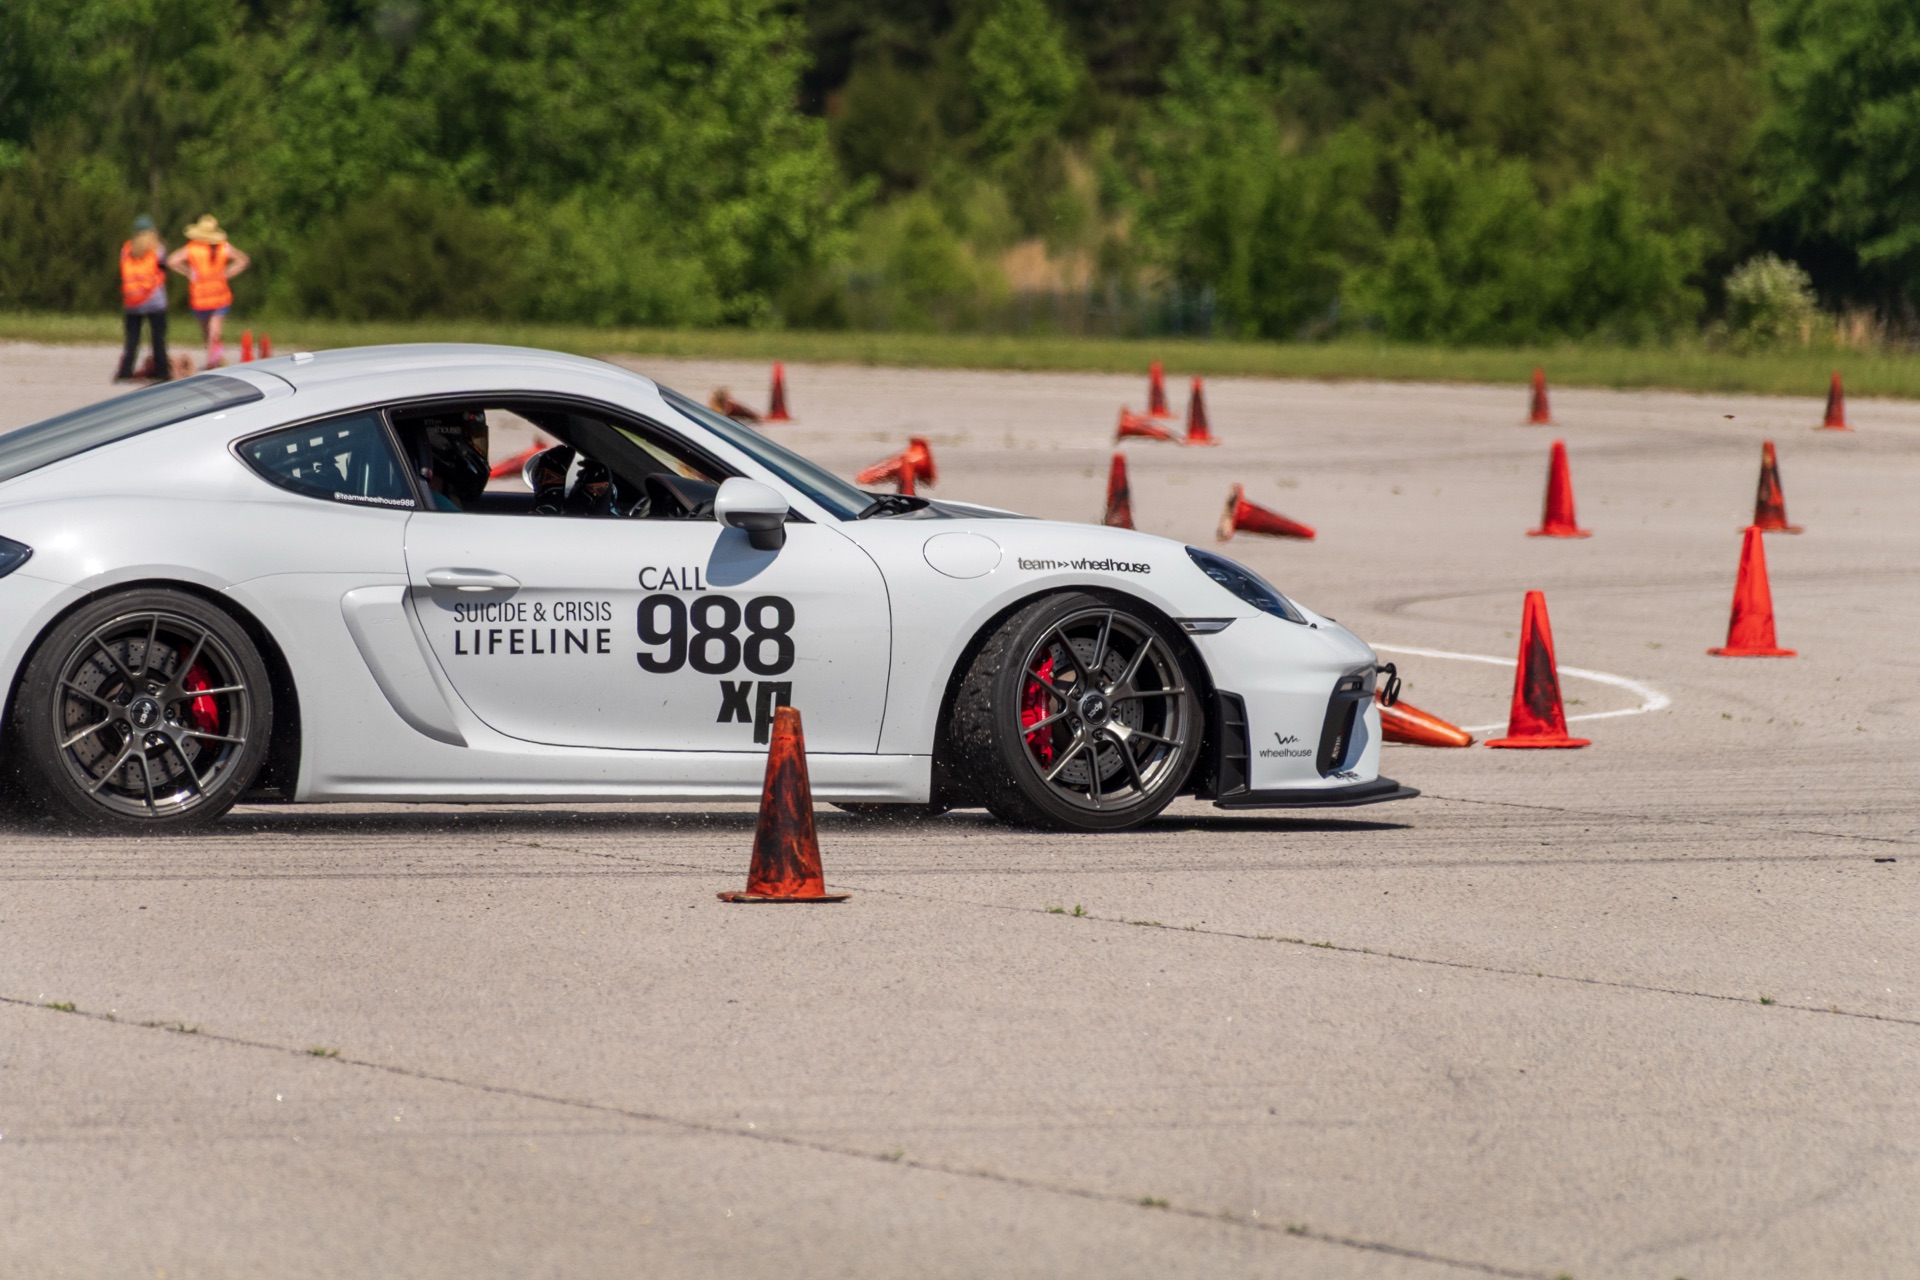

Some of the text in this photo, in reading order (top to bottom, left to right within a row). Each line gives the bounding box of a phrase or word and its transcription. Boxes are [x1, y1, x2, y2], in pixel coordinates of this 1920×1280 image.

[334, 491, 415, 507] @teamwheelhouse988
[1018, 557, 1151, 574] team wheelhouse
[638, 566, 706, 591] CALL
[454, 601, 612, 622] SUICIDE & CRISIS
[455, 628, 611, 655] LIFELINE
[637, 594, 795, 676] 988
[1259, 748, 1312, 758] wheelhouse
